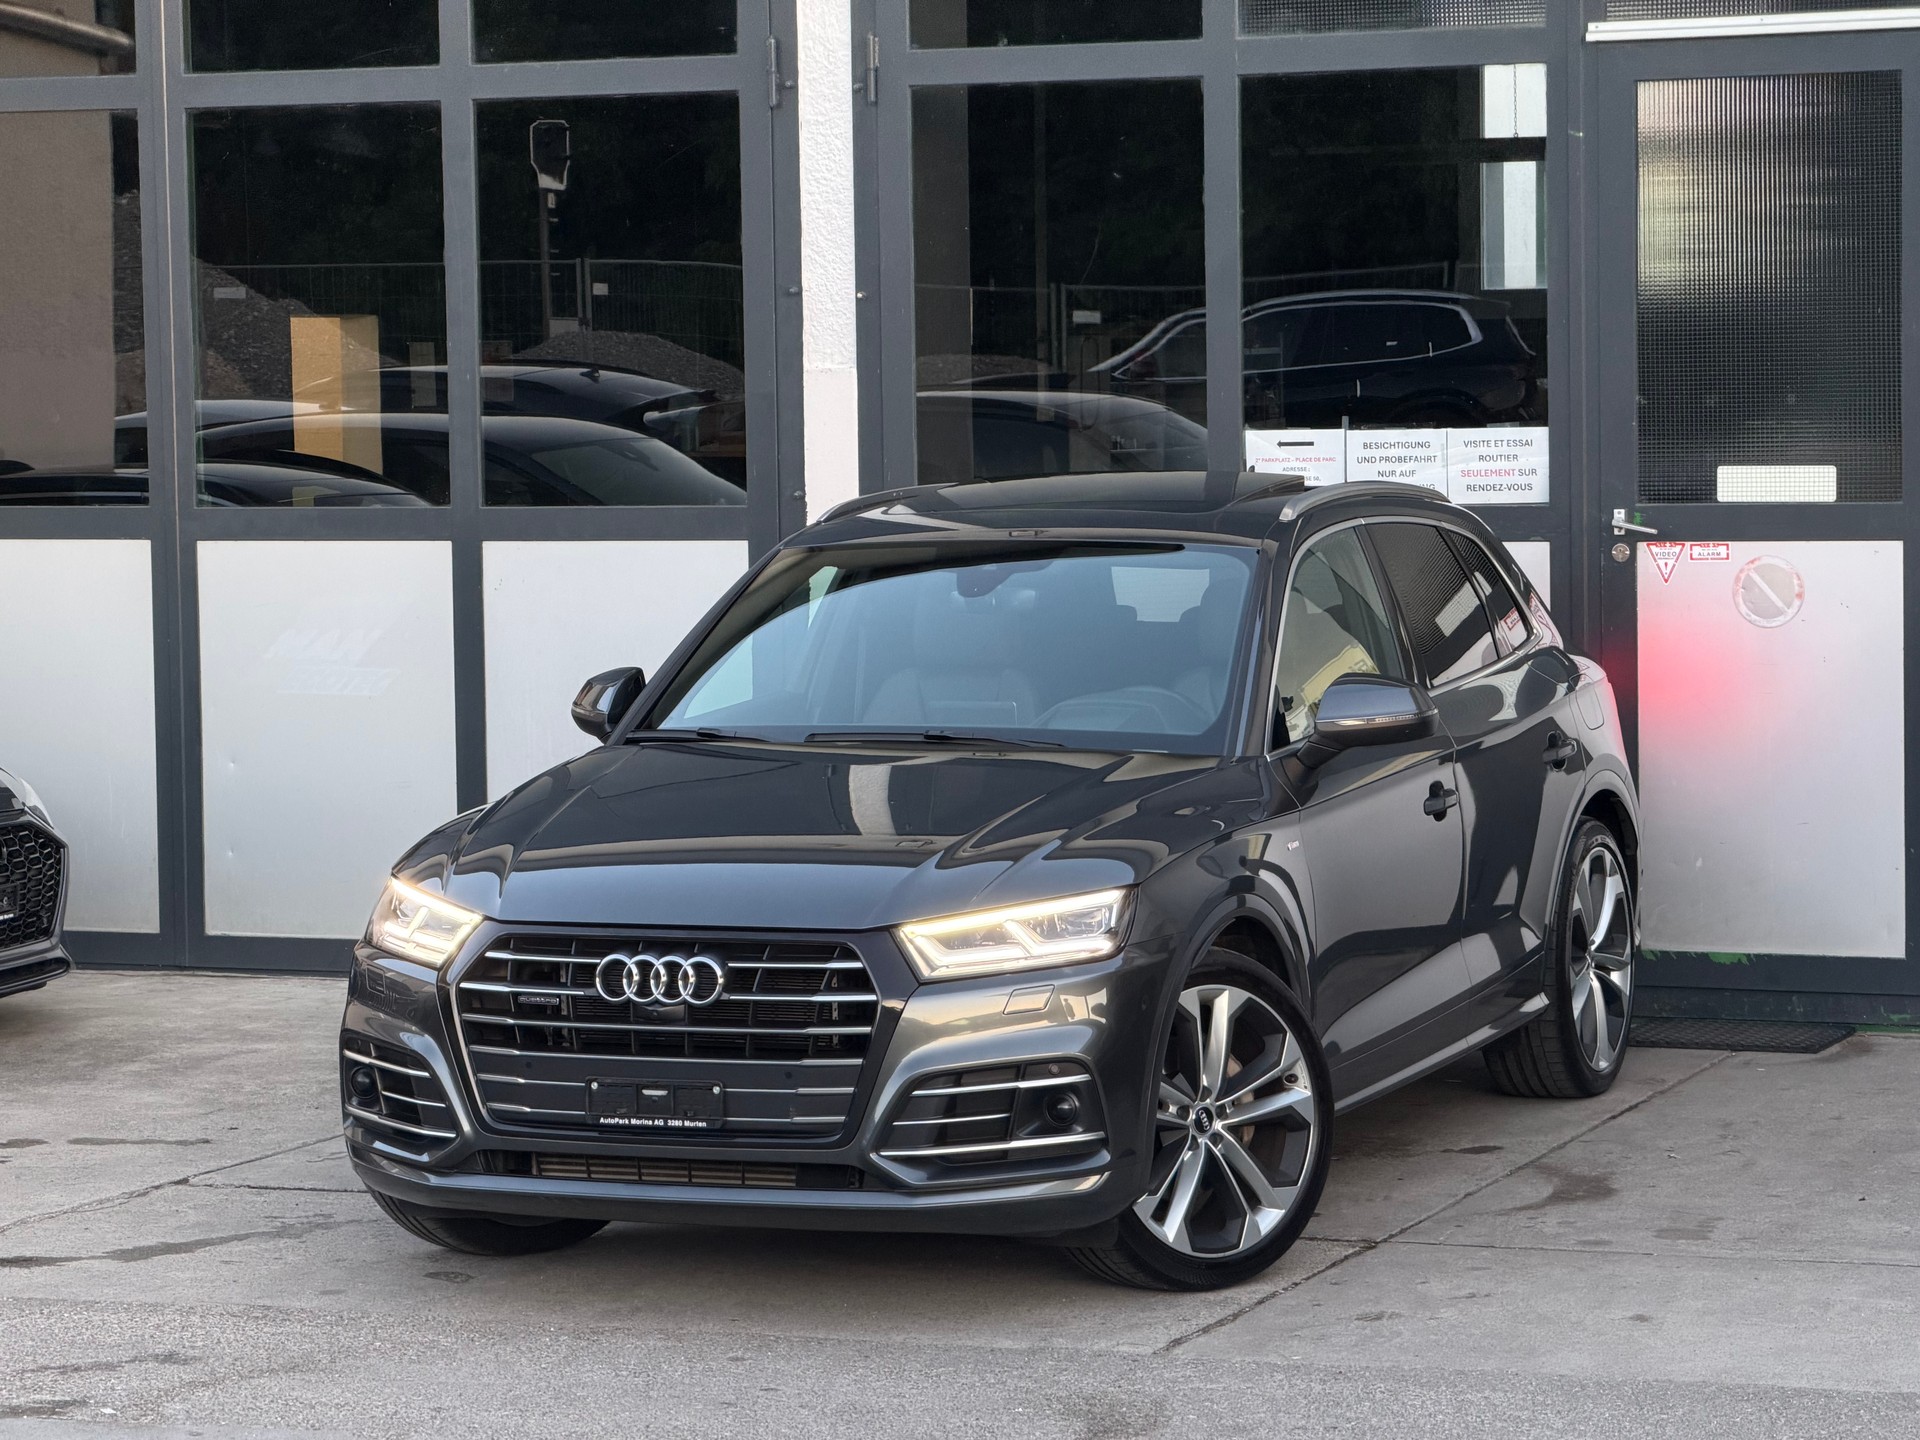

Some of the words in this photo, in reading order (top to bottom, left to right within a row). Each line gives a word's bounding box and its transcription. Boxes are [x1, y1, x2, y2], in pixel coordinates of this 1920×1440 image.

[1363, 441, 1431, 450] BESICHTIGUNG
[1463, 440, 1492, 448] VISITE
[1494, 439, 1505, 448] ET
[1506, 439, 1533, 448] ESSAI
[1357, 456, 1377, 464] UND
[1379, 455, 1437, 464] PROBEFAHRT
[1478, 454, 1519, 463] ROUTIER
[1377, 470, 1397, 478] NUR
[1398, 469, 1416, 478] AUF
[1460, 469, 1516, 478] SEULEMENT
[1518, 468, 1537, 477] SUR
[1466, 483, 1533, 492] RENDEZ-VOUS
[600, 1117, 629, 1125] AutoPark
